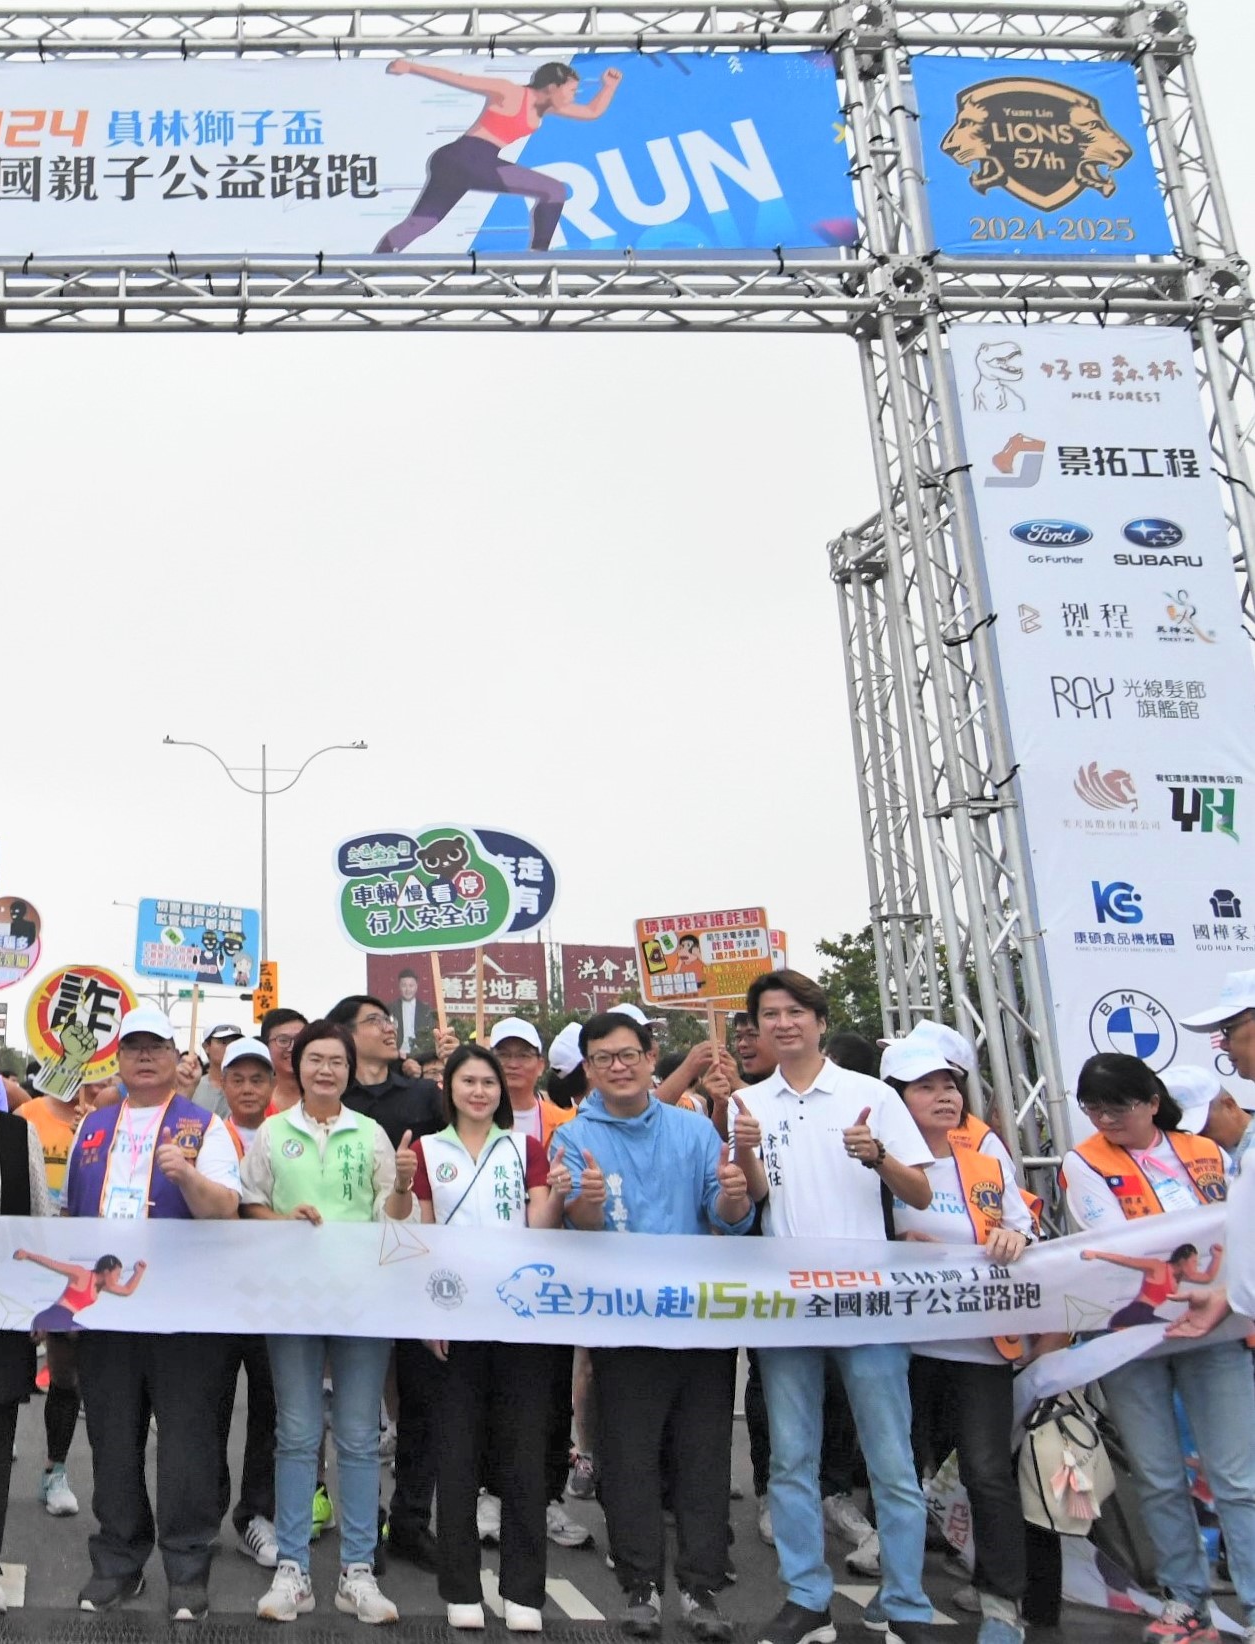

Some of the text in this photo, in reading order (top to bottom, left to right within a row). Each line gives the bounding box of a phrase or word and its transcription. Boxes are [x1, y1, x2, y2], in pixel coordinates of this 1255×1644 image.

[1003, 107, 1053, 117] Yuan Lin
[105, 109, 325, 149] 員林獅子盃
[991, 122, 1074, 144] LIONS
[1014, 149, 1065, 170] 57th
[525, 119, 784, 247] RUN
[969, 217, 1135, 242] 2024-2025
[1072, 391, 1161, 402] NICE FOREST
[1057, 446, 1200, 478] 景拓工程
[1026, 522, 1076, 543] Ford
[1028, 554, 1083, 564] Go Further
[1113, 553, 1203, 567] SUBARU
[1051, 676, 1114, 719] RAY
[367, 901, 490, 936] 行人安全行
[644, 909, 760, 935] 猜猜我是誰詐騙
[1192, 923, 1255, 941] 國樺家
[1196, 943, 1213, 953] GUO
[1215, 944, 1232, 953] HUA
[50, 972, 122, 1034] 詐
[1098, 993, 1162, 1018] BMW
[337, 1144, 355, 1201] 陳素月
[494, 1165, 512, 1221] 張欣倩
[788, 1268, 882, 1290] 2024
[536, 1281, 798, 1321] 全力以赴 15th
[804, 1281, 1042, 1320] 全國親子公益路跑
